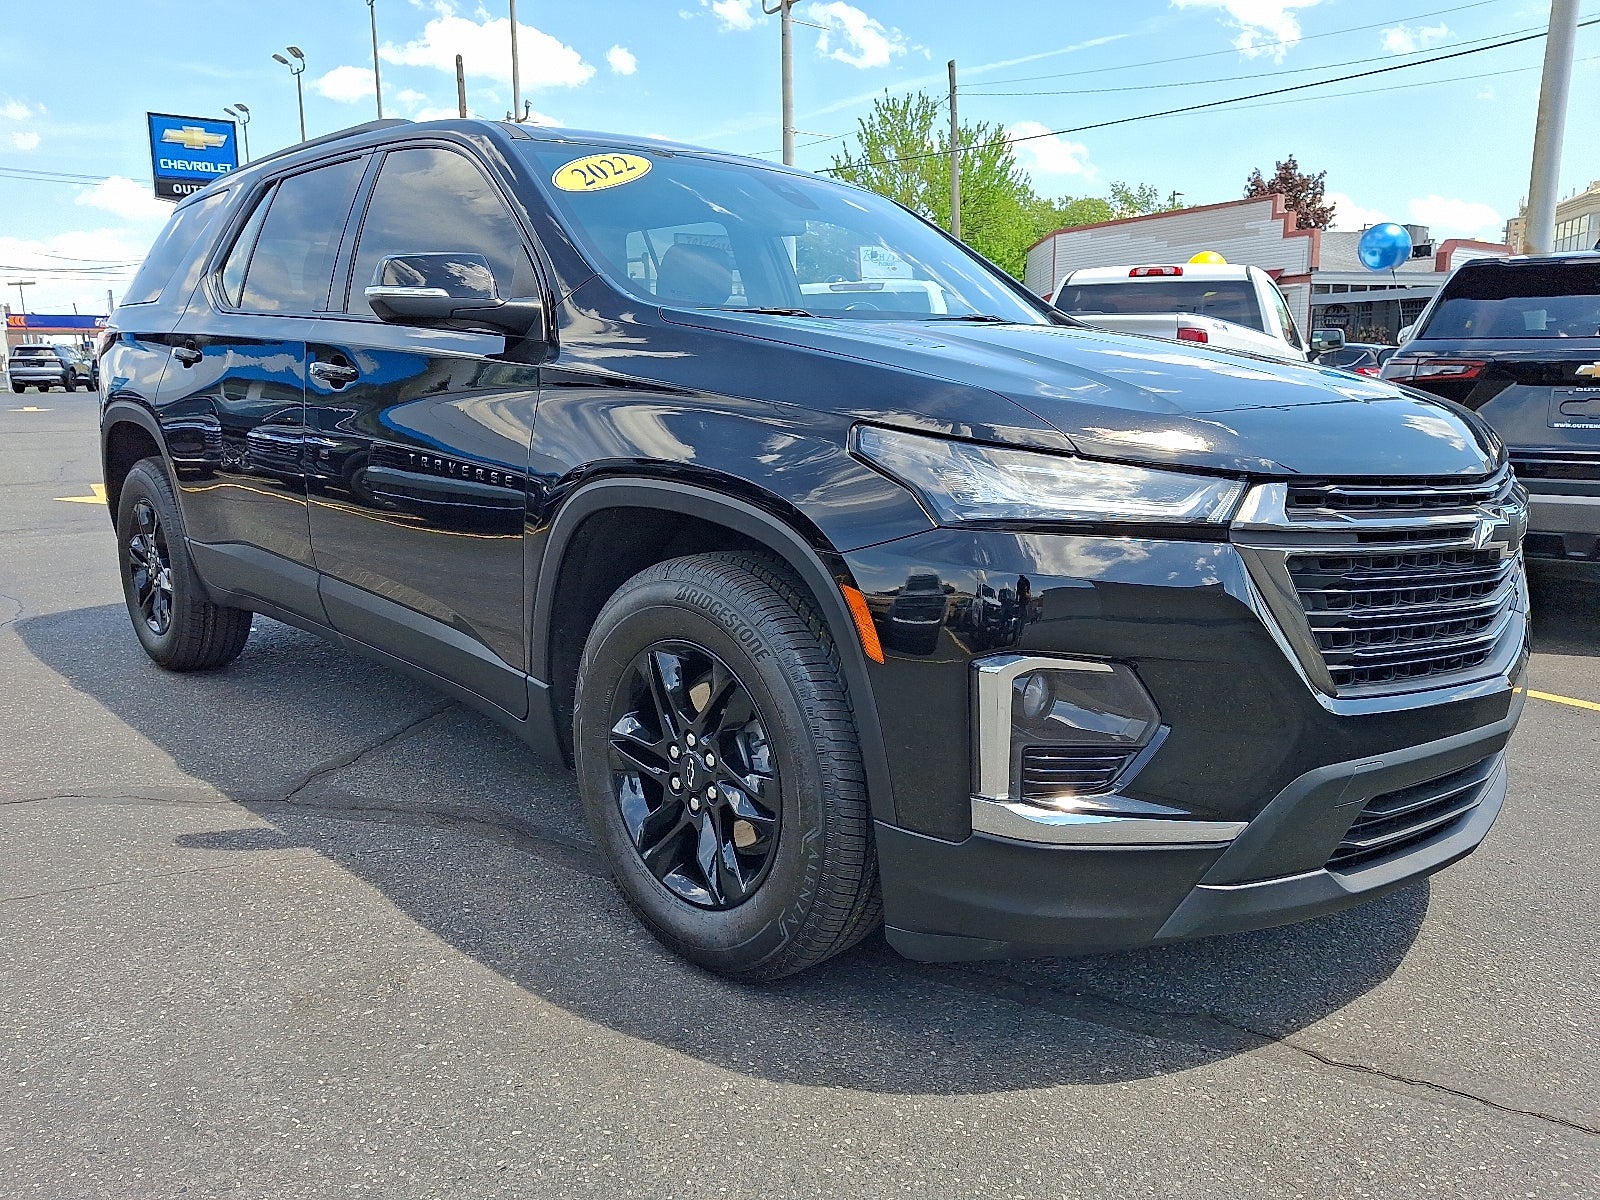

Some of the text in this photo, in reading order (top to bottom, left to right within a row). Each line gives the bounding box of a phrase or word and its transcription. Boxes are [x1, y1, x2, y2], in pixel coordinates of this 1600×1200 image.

[159, 158, 232, 173] CHEVROLET
[570, 156, 637, 187] 2022
[172, 183, 206, 195] OUT
[408, 453, 513, 488] TRAVERSE
[674, 584, 771, 663] BRIDGESTONE
